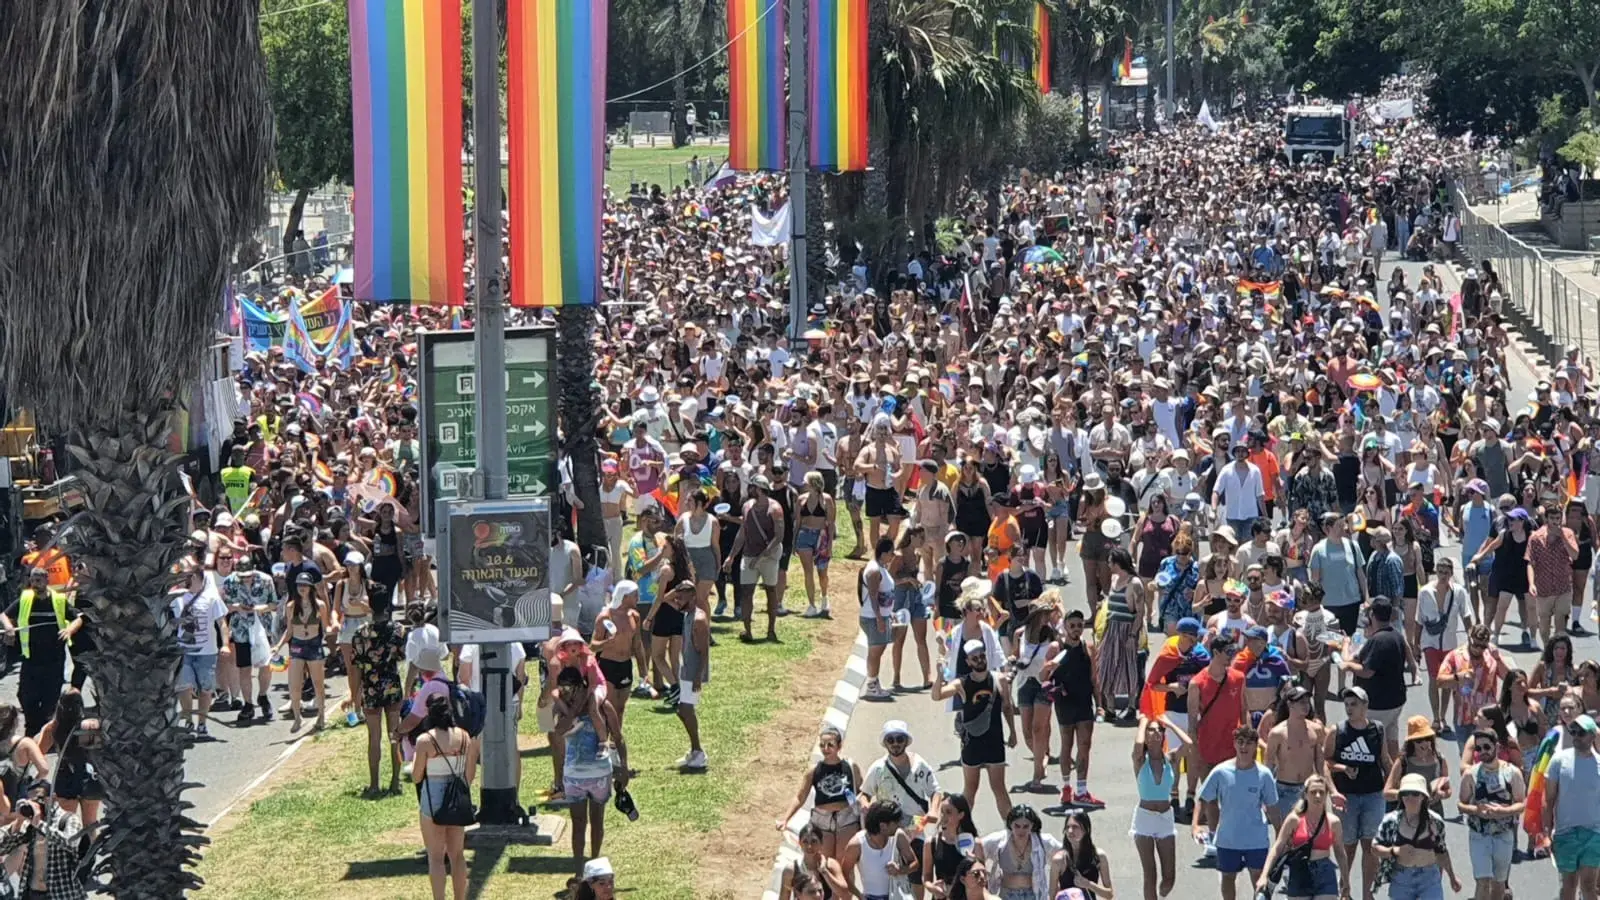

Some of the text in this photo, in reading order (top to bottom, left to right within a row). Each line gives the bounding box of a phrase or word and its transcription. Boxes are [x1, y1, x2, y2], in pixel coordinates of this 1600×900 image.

[458, 447, 476, 458] Exp
[487, 554, 514, 566] 10.6
[1340, 751, 1375, 762] adidas
